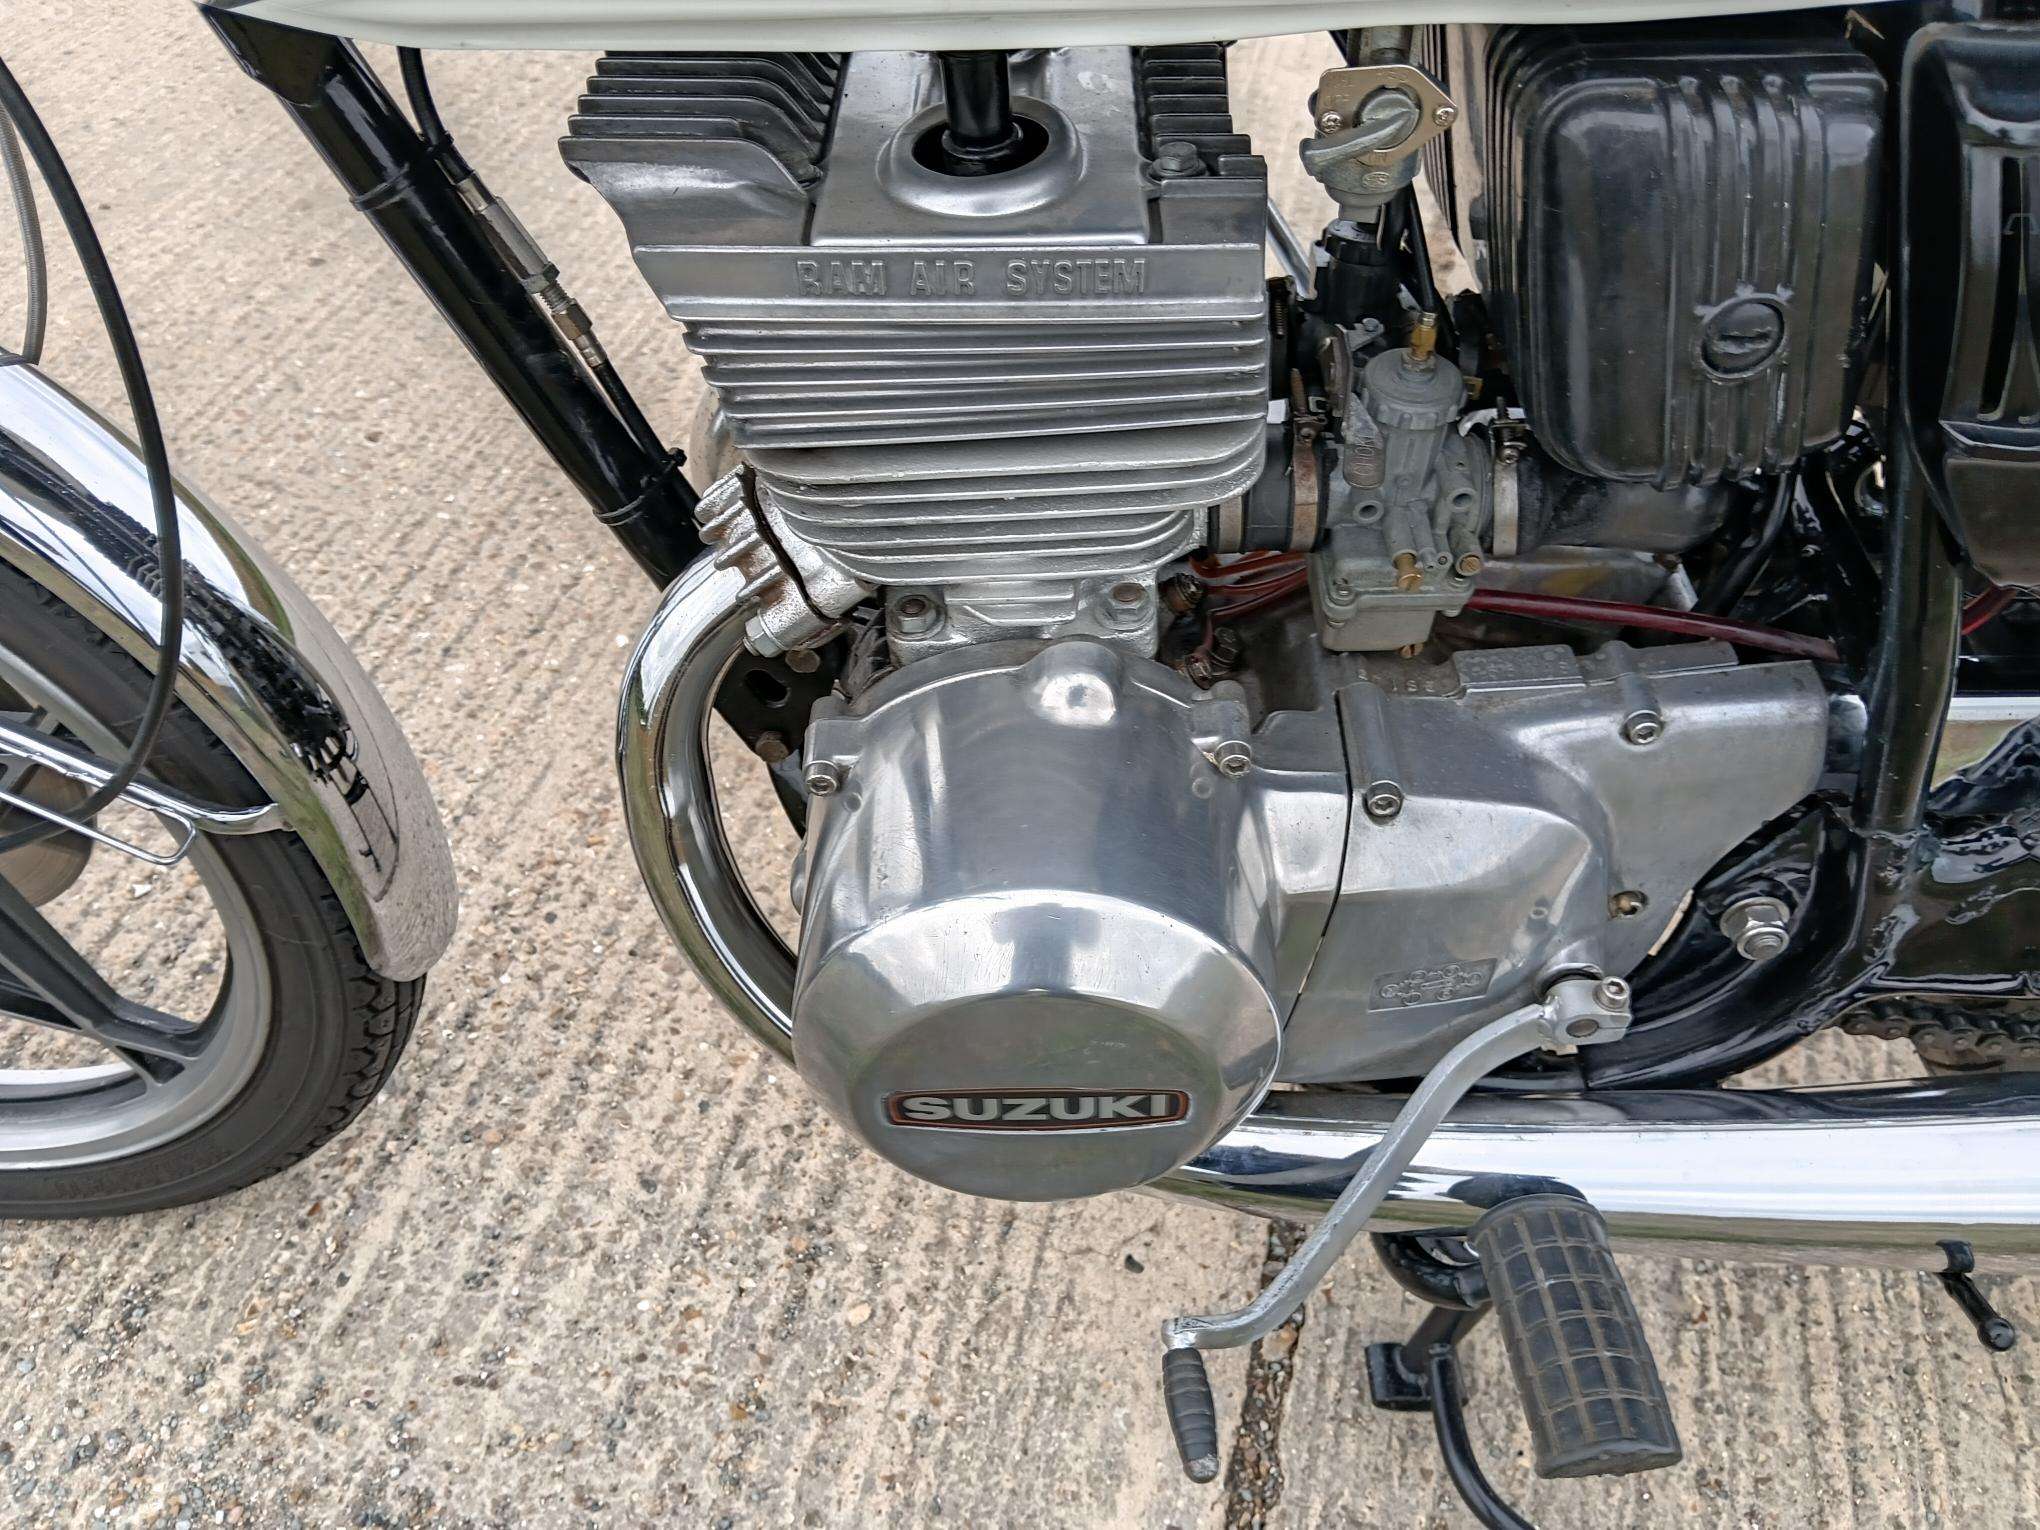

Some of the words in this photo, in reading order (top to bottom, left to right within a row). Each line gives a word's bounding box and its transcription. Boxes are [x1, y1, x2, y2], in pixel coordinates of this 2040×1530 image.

[797, 260, 887, 295] RAM
[910, 260, 976, 296] AIR
[1006, 258, 1146, 295] SYSTEM
[902, 1094, 1167, 1121] SUZUKI
